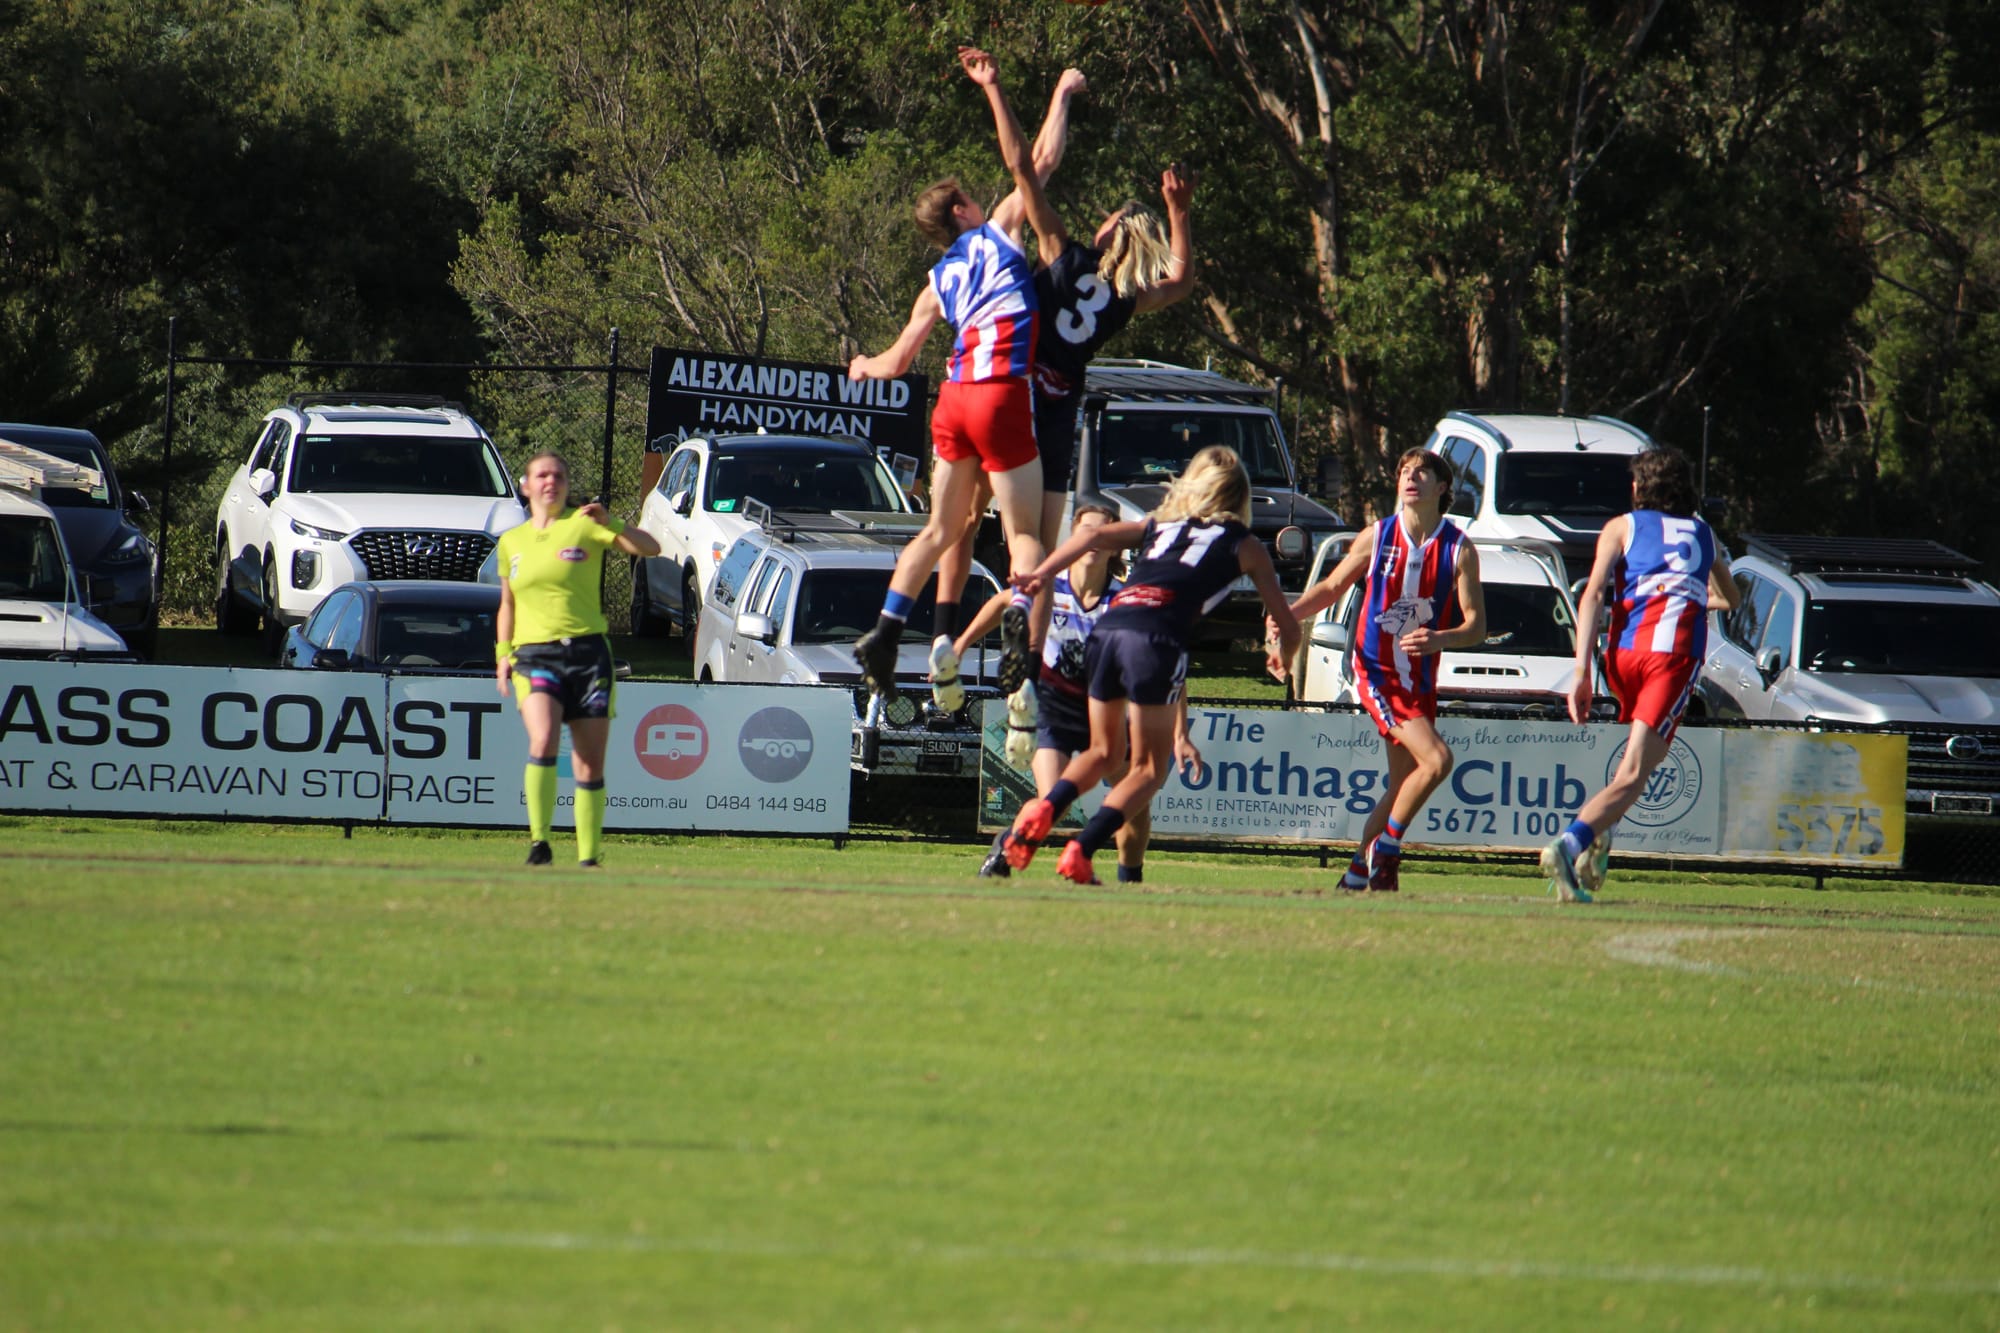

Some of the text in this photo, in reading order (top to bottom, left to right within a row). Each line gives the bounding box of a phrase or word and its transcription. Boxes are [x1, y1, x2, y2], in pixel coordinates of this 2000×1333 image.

[1055, 272, 1111, 344] 3
[667, 356, 910, 409] ALEXANDER WILD
[700, 399, 871, 438] HANDYMAN
[1661, 516, 1703, 573] 5
[202, 691, 502, 760] COAST
[1203, 711, 1265, 743] The
[1474, 726, 1500, 745] the
[47, 761, 77, 790] &
[91, 762, 287, 796] CARAVAN
[302, 769, 495, 804] STORAGE
[1452, 759, 1587, 810] Club
[706, 794, 751, 811] 0484
[757, 796, 788, 811] 144
[793, 797, 827, 813] 948
[1167, 796, 1337, 818] BARS ENTERTAINMENT
[1427, 807, 1497, 835] 5672
